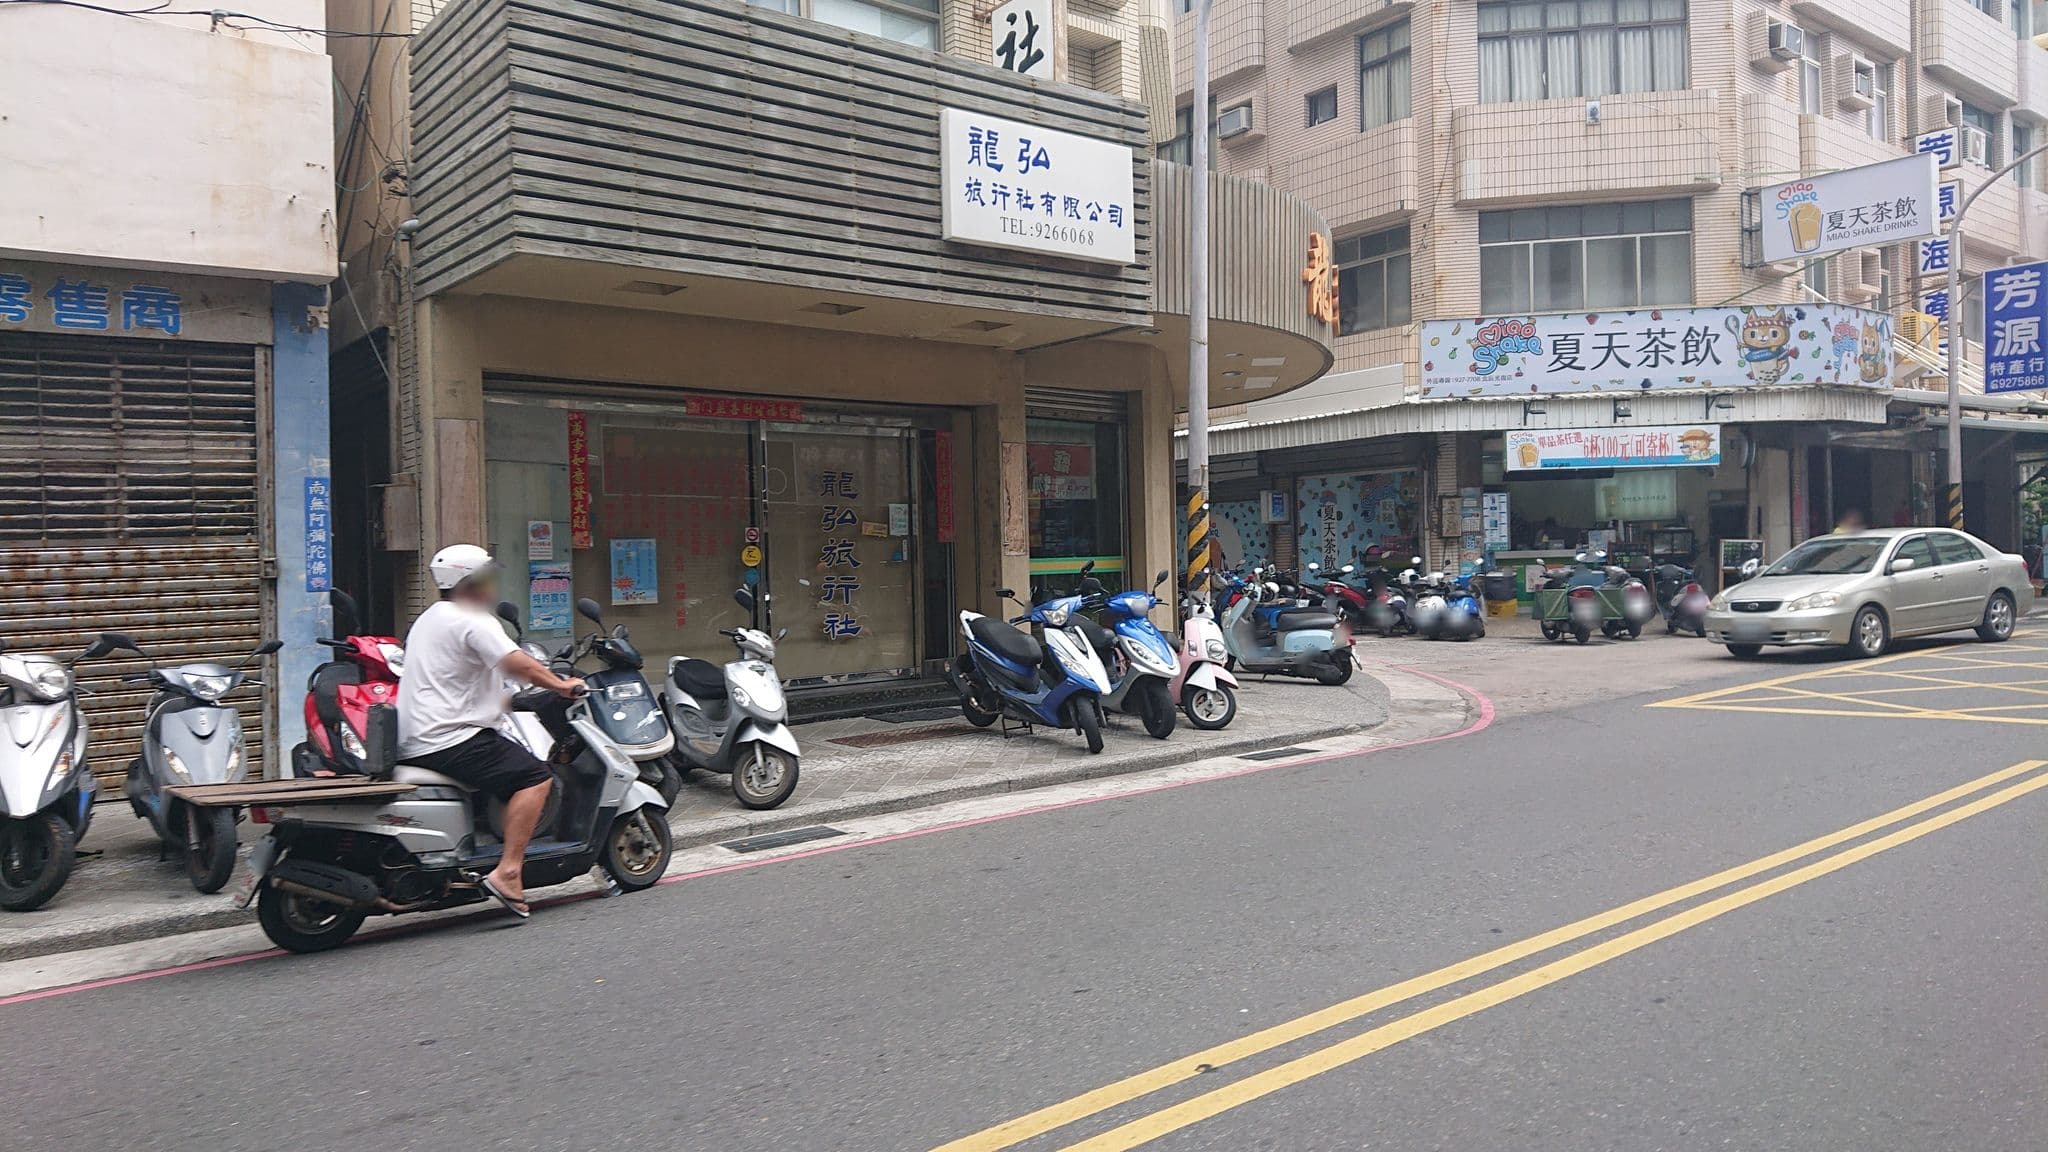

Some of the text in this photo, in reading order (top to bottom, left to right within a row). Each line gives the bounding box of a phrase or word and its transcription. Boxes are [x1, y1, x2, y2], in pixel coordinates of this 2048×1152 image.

[996, 10, 1044, 73] 社
[967, 126, 1051, 174] 龍弘
[964, 177, 1123, 228] 旅行社有限公司
[1775, 191, 1818, 220] Shake
[1778, 182, 1813, 201] Miao
[1826, 196, 1917, 233] 夏天茶飲
[1000, 216, 1095, 246] TEL:9266068
[1826, 218, 1918, 243] MIAO SHAKE DRINKS
[1993, 269, 2042, 358] 芳源
[1546, 325, 1723, 373] 夏天茶飲
[1990, 357, 2045, 376] 特產行
[1999, 375, 2045, 389] 9275866
[308, 480, 327, 576] 南無阿彌陀佛
[1323, 504, 1336, 571] 夏天茶飲
[819, 471, 862, 641] 龍弘旅行社
